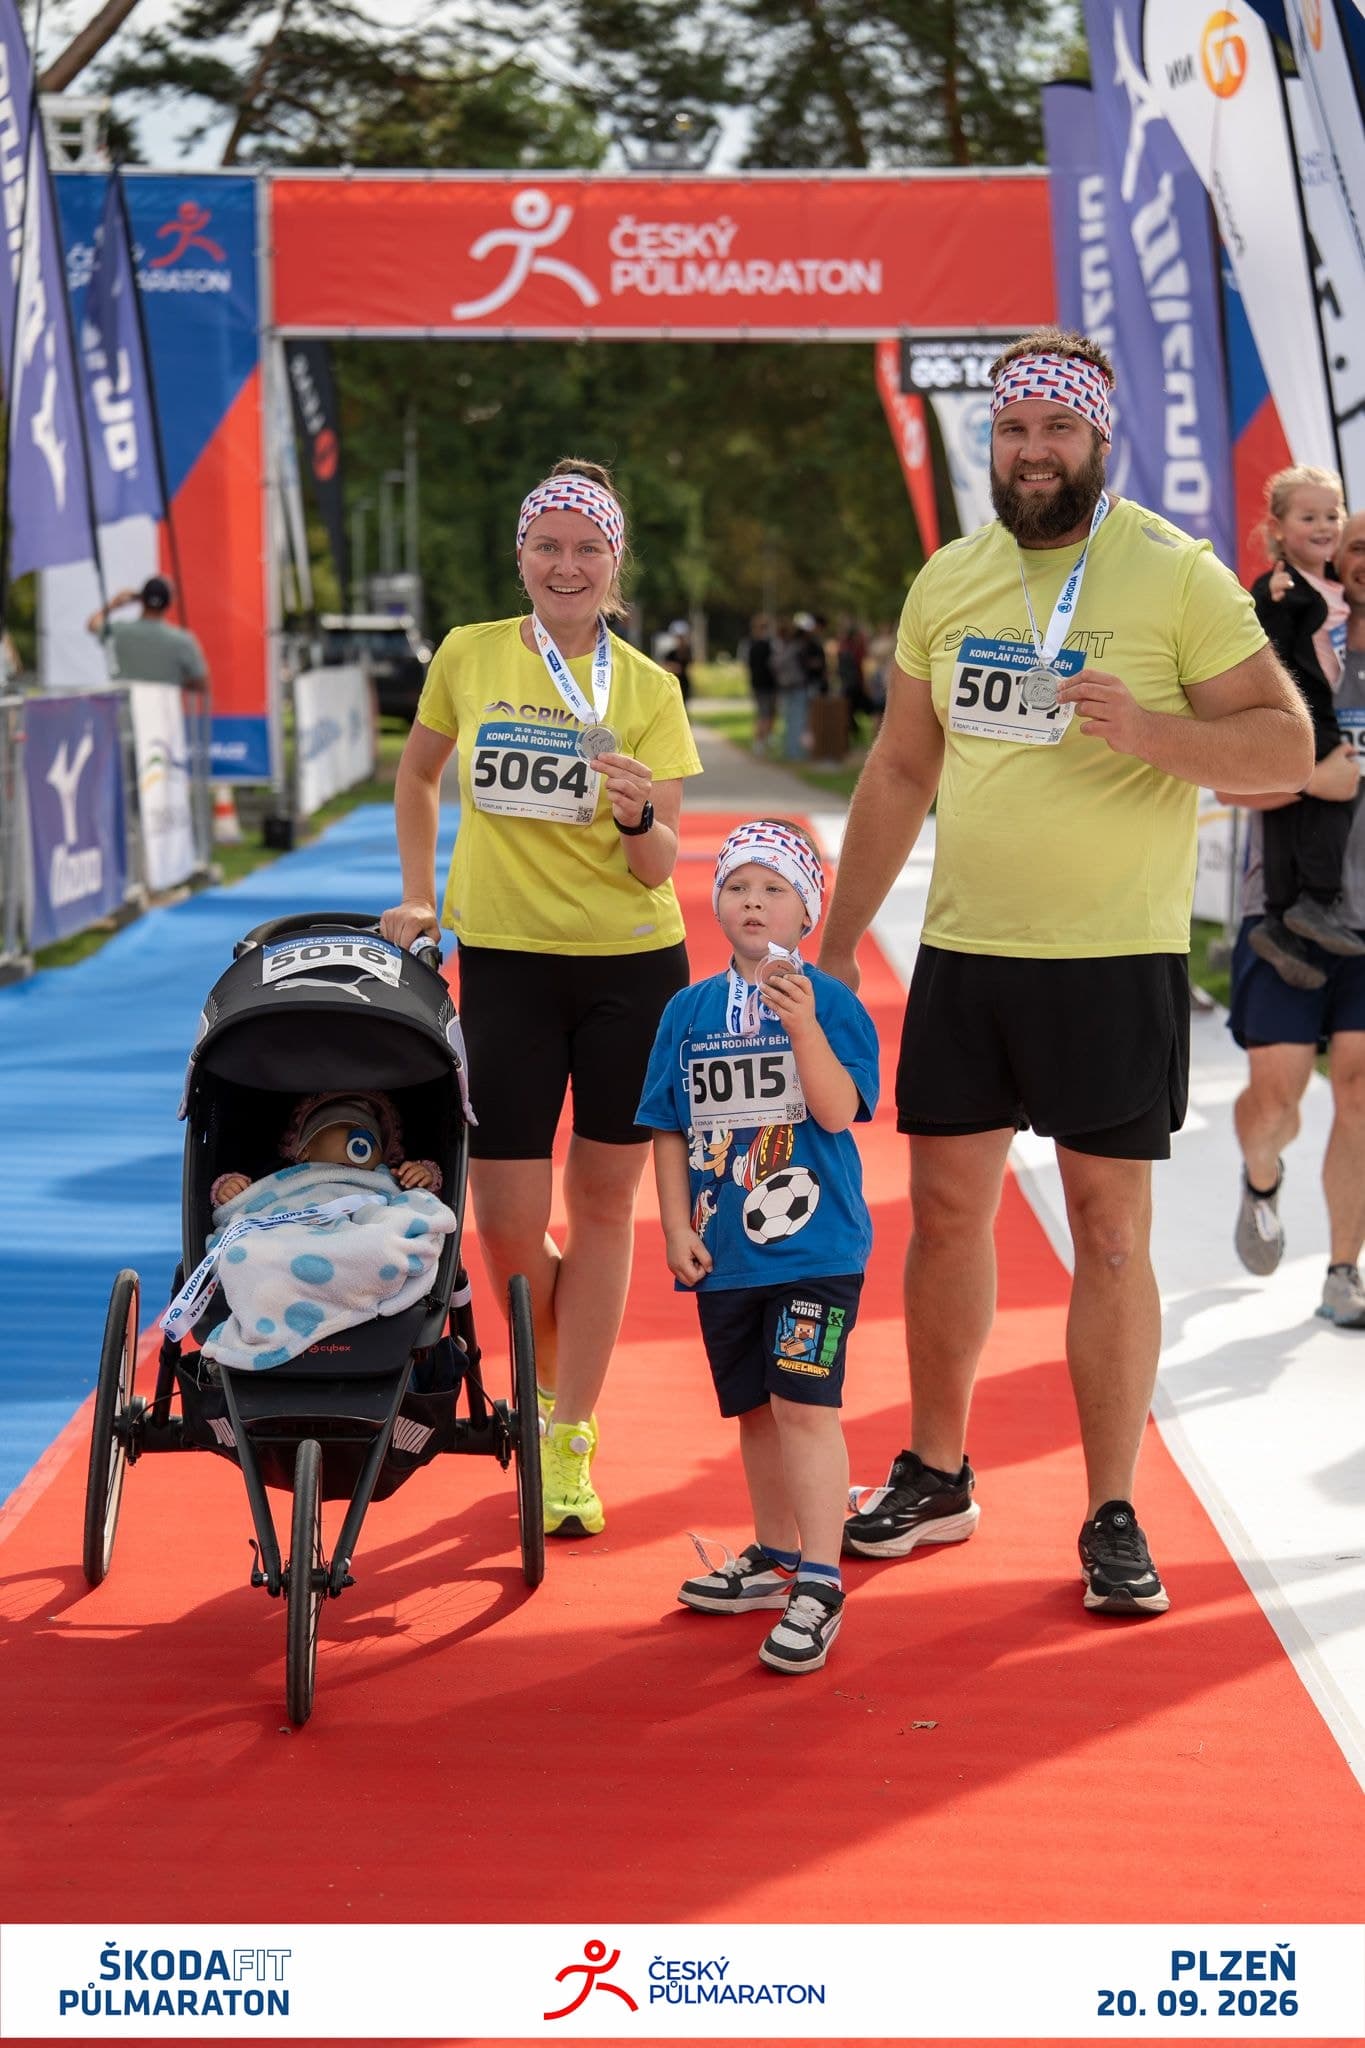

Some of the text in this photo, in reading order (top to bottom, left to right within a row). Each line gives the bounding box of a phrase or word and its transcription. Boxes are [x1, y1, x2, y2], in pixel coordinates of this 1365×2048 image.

[609, 214, 738, 259] ČESKÝ
[610, 256, 882, 296] PŮLMARATON
[1062, 576, 1078, 602] ŠKODA
[969, 650, 1010, 662] KONPLAN
[1054, 660, 1073, 671] BĚH
[486, 732, 529, 743] KONPLAN
[530, 735, 573, 750] RODINNÝ
[474, 750, 588, 799] 5064
[270, 945, 387, 972] 5016
[722, 1035, 767, 1050] RODINNÝ
[769, 1035, 789, 1046] BĚH
[692, 1055, 786, 1104] 5015
[190, 1295, 209, 1318] LEAR
[791, 1305, 823, 1319] MODE
[792, 1299, 823, 1310] SURVIVAL
[321, 1345, 351, 1354] cybex
[777, 1358, 830, 1377] MINECRAFT
